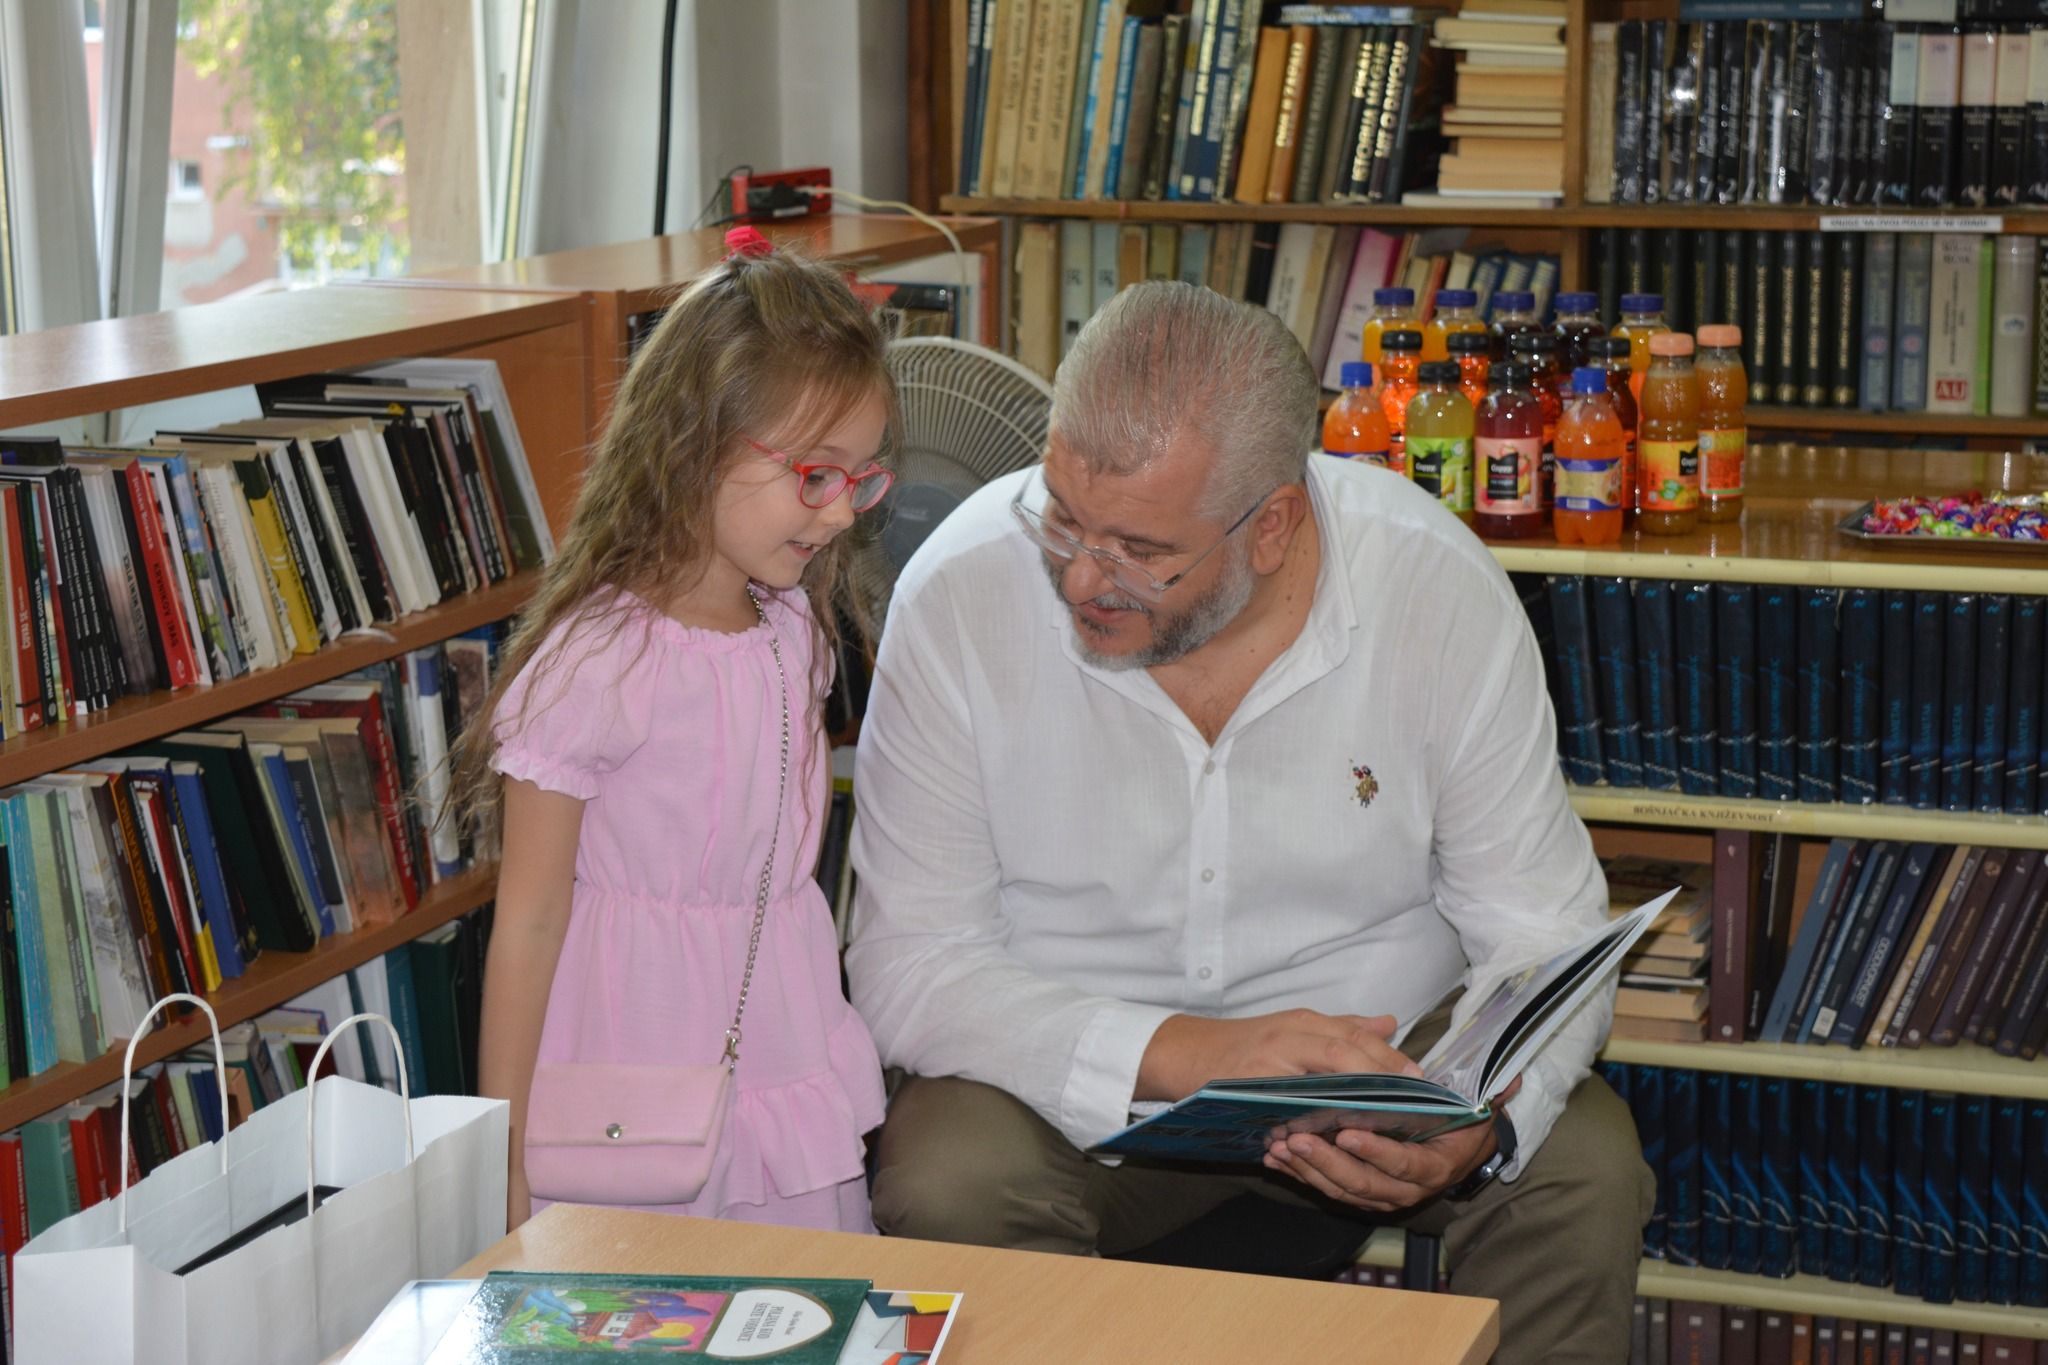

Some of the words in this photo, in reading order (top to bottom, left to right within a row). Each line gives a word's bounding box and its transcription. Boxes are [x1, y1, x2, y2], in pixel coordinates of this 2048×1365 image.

[1937, 382, 1967, 400] AU
[1633, 805, 1696, 818] BOŠNJAČKA
[1699, 808, 1774, 822] KNJIŽEVNOST
